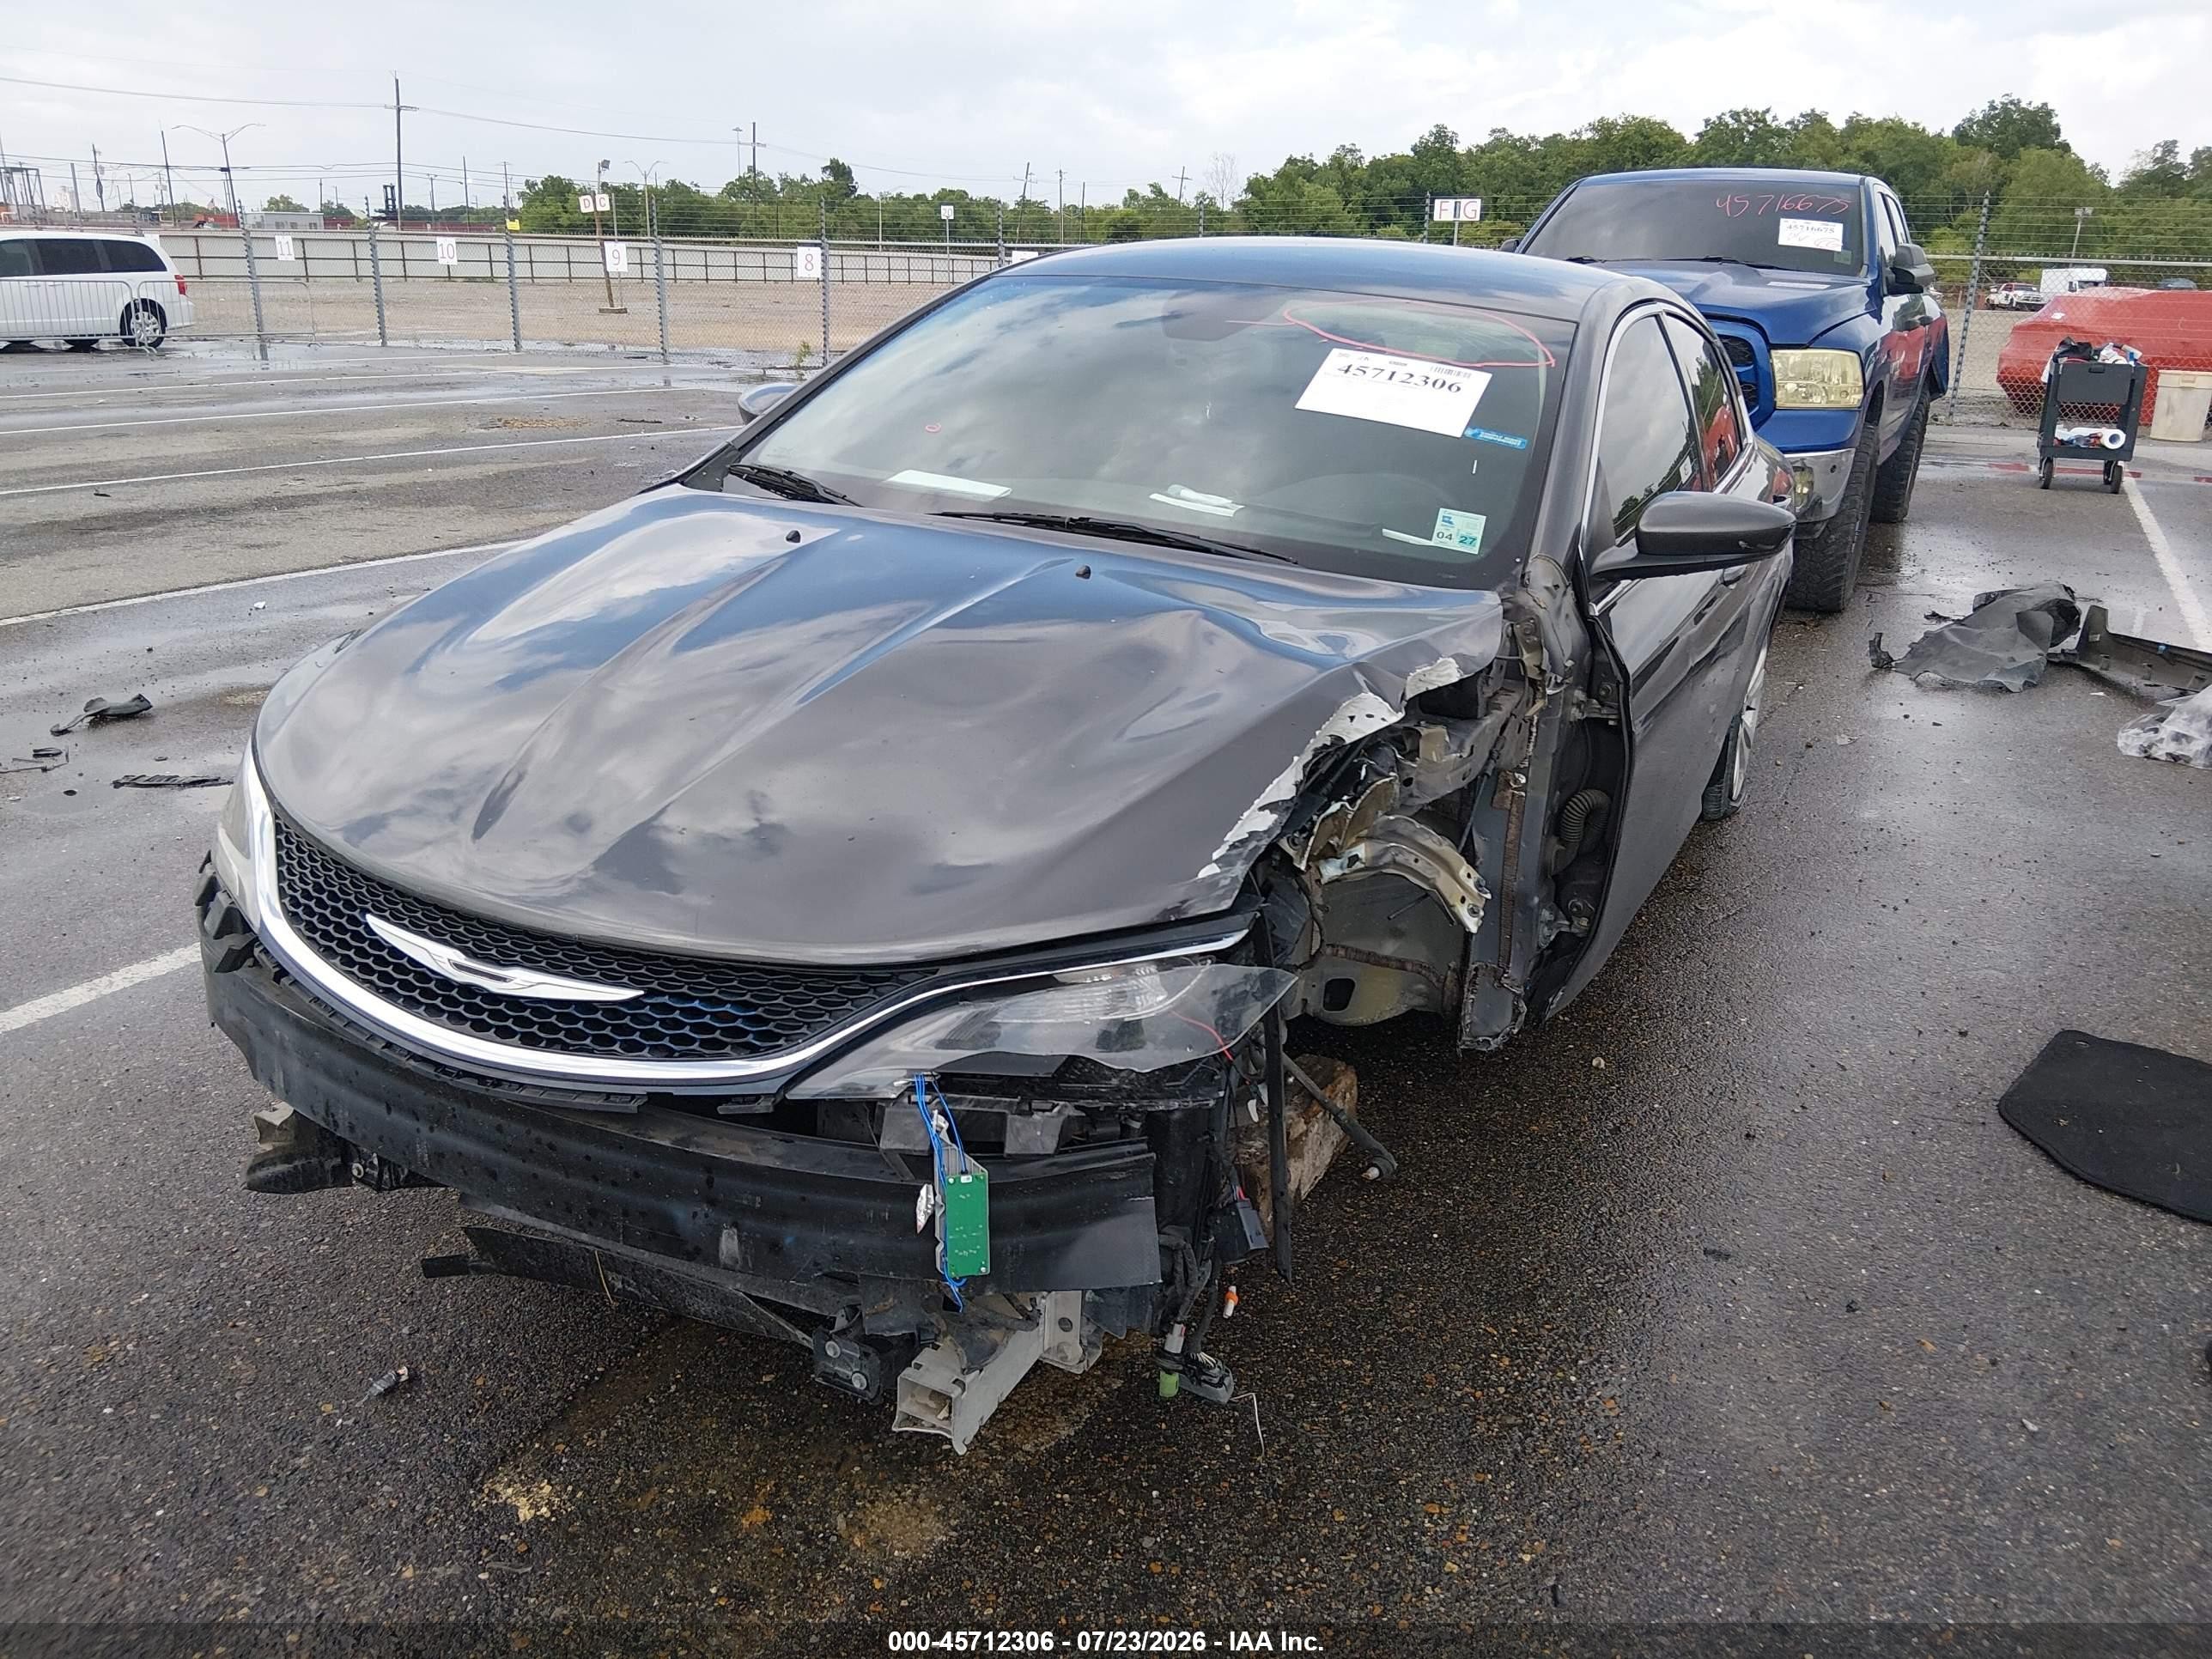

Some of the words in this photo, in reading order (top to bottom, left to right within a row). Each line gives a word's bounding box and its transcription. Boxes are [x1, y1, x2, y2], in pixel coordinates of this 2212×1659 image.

[583, 198, 591, 209] D
[599, 198, 606, 207] C
[1716, 193, 1853, 217] 45716675
[1786, 223, 1835, 234] 45716675
[277, 240, 293, 256] 11
[439, 243, 455, 259] 10
[611, 249, 621, 265] 9
[805, 253, 814, 271] 8
[1337, 363, 1462, 393] 45712306
[1436, 531, 1453, 541] 04
[1459, 535, 1477, 545] 27
